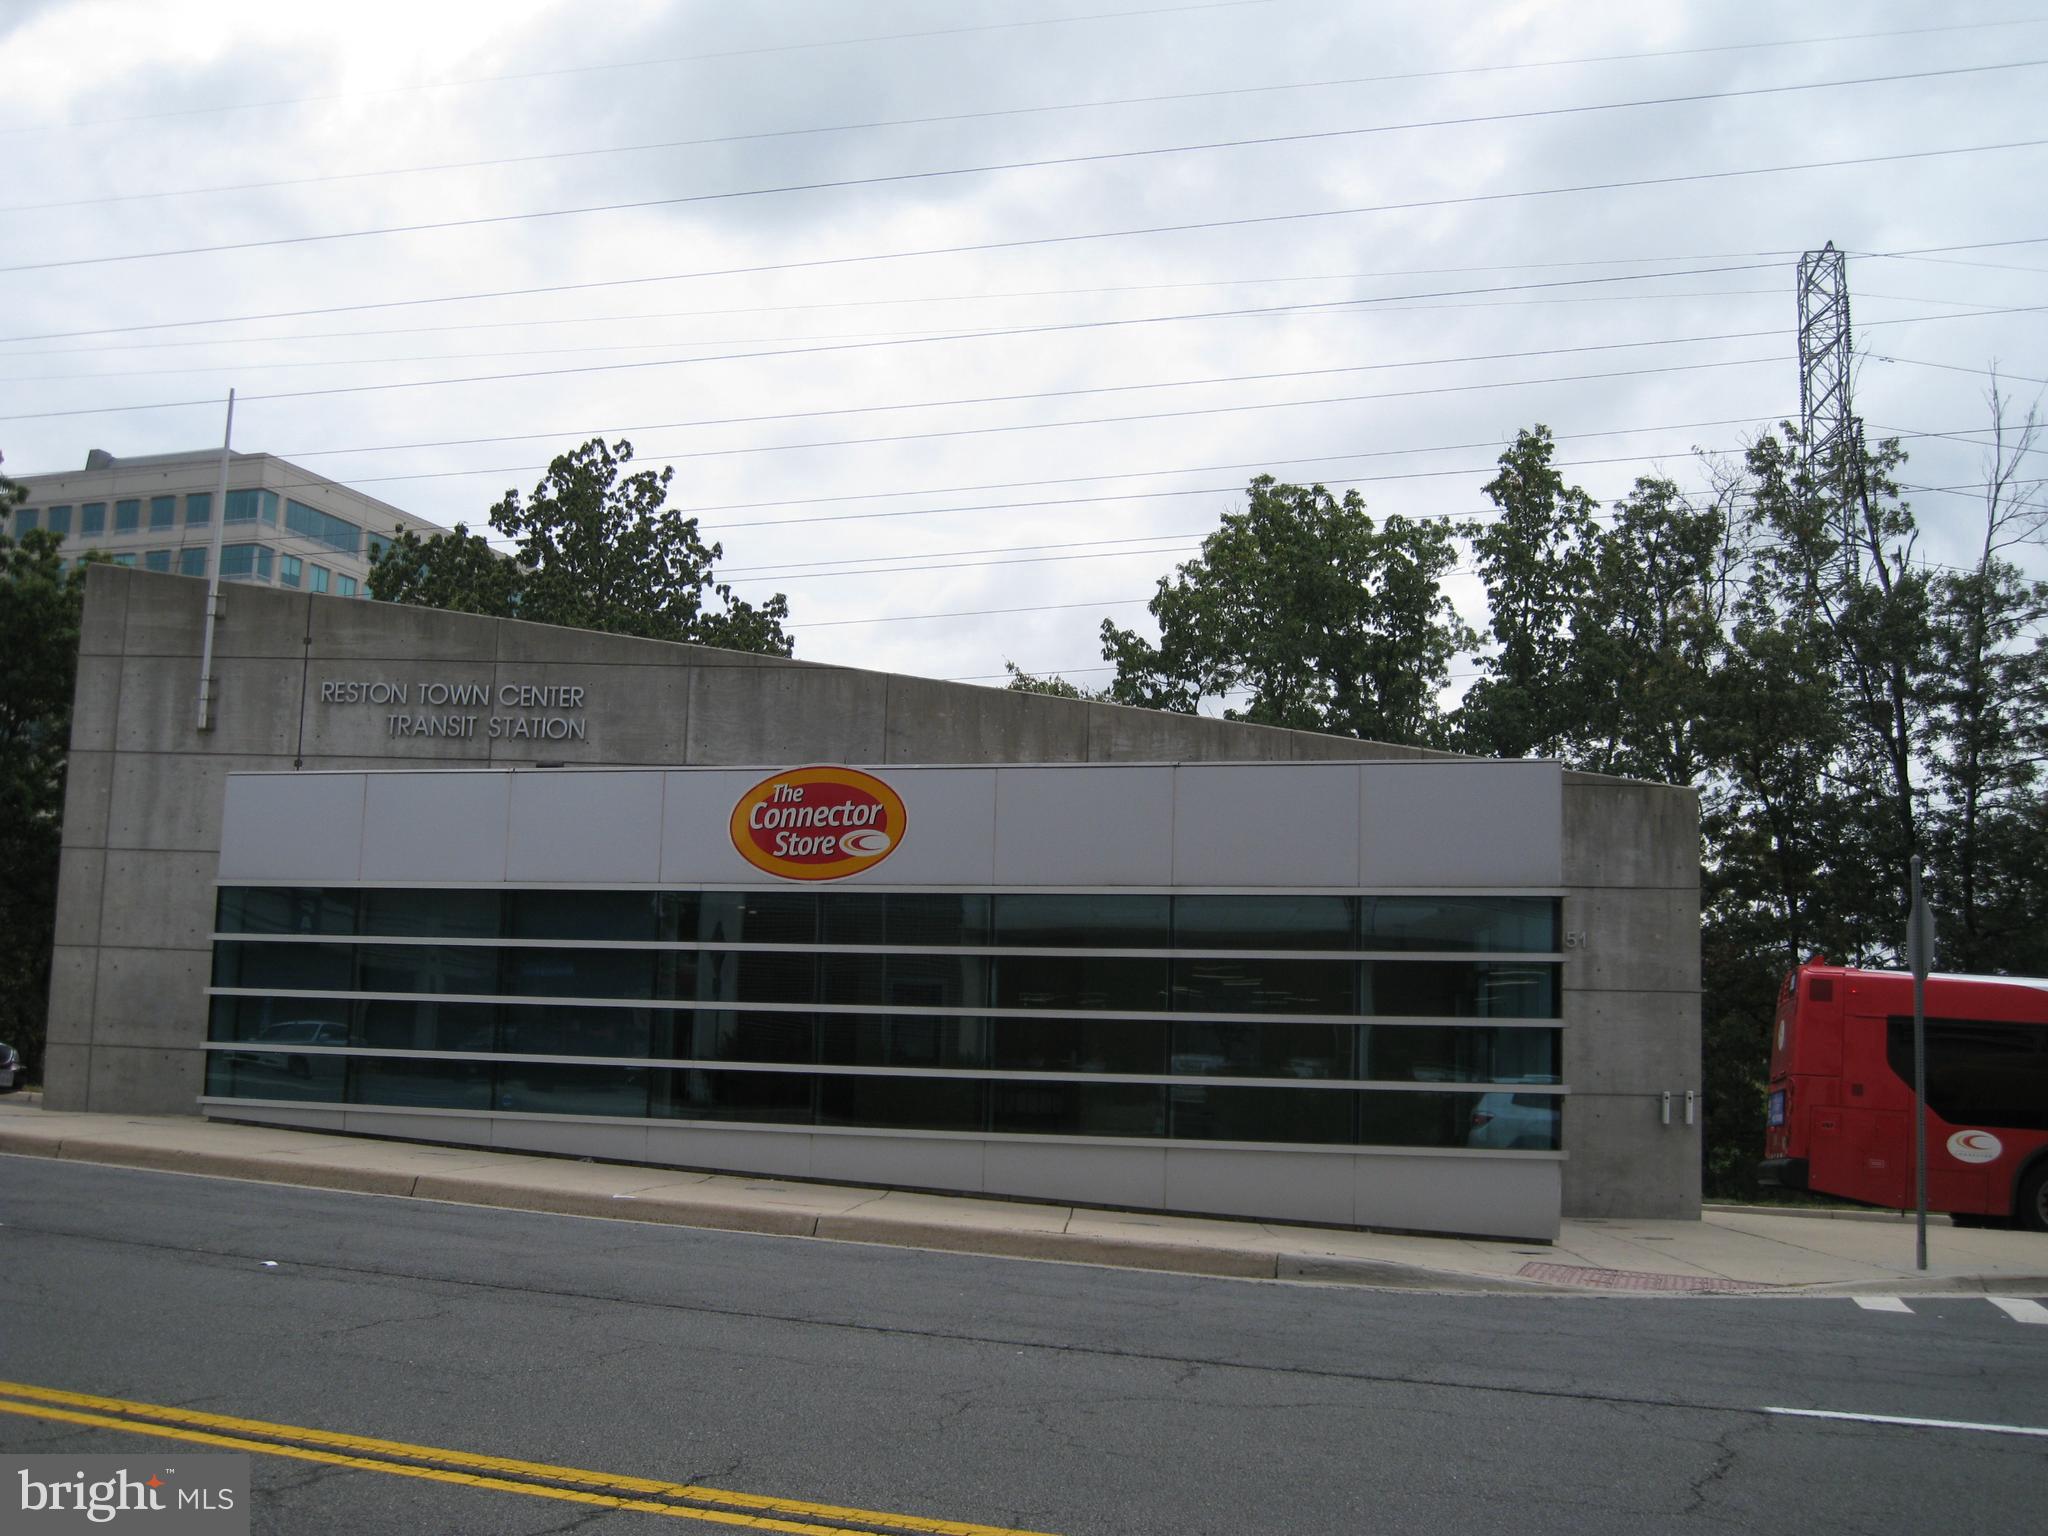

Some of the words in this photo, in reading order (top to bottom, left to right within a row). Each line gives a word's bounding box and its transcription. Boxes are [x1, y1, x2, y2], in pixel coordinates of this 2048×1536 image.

[321, 681, 407, 704] RESTON
[418, 683, 489, 706] TOWN
[500, 685, 584, 707] CENTER
[388, 714, 477, 737] TRANSIT
[488, 716, 585, 739] STATION
[773, 783, 804, 803] The
[750, 800, 884, 830] Connector
[773, 831, 836, 857] Store
